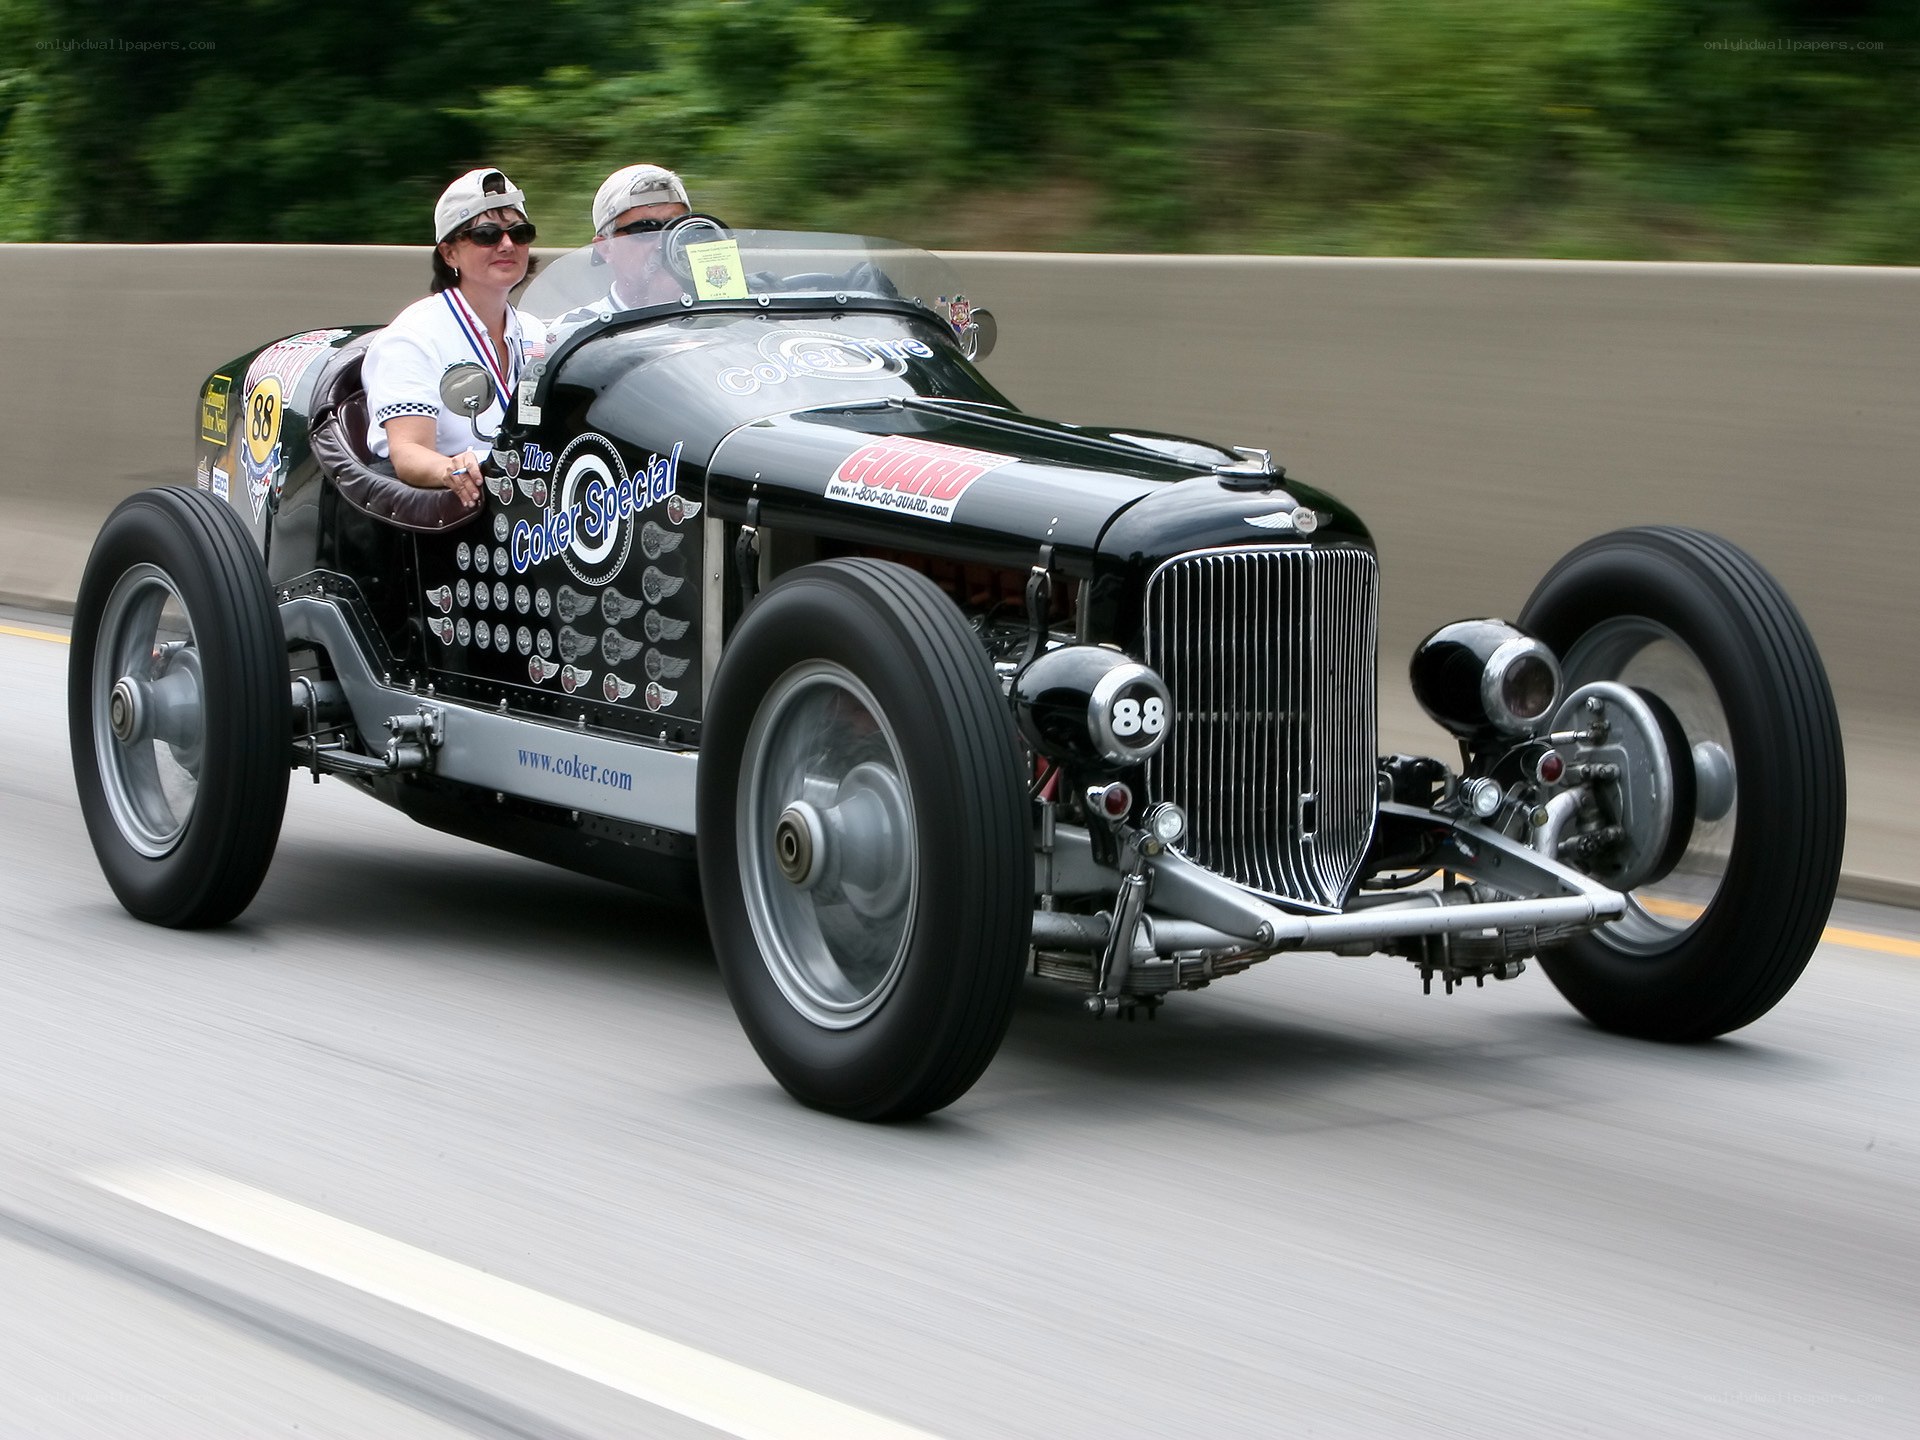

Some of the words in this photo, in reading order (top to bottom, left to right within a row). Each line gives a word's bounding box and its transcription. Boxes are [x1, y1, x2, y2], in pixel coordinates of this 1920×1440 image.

[717, 347, 848, 395] Coker
[842, 338, 934, 362] Tire
[252, 393, 275, 441] 88
[522, 443, 553, 472] The
[838, 446, 985, 501] GUARD
[512, 501, 583, 574] Coker
[584, 440, 684, 542] Special
[1112, 696, 1165, 736] 88
[518, 749, 632, 791] www.coker.com
